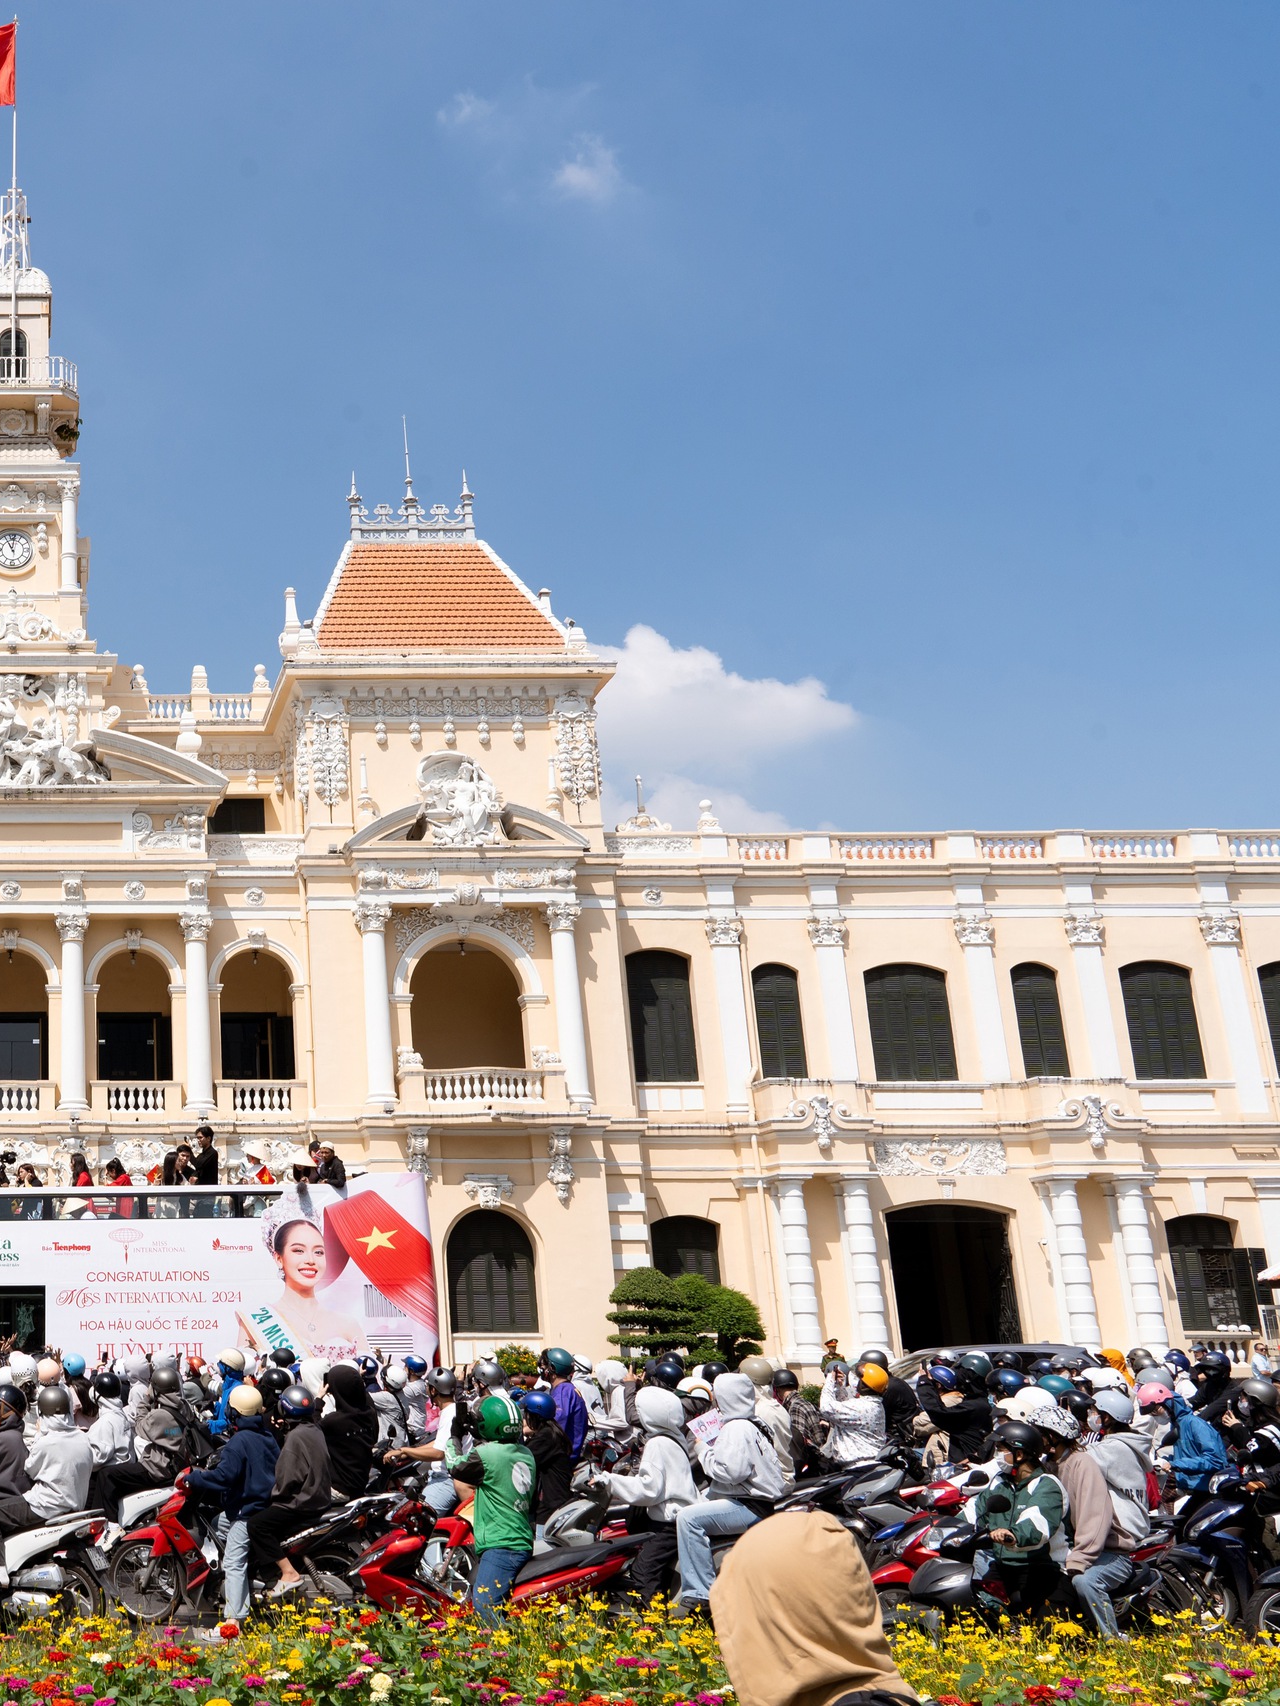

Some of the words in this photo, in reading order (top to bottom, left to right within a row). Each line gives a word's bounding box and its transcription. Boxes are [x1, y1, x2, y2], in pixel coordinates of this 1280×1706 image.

[86, 1271, 210, 1282] CONGRATULATIONS
[105, 1291, 206, 1304] INTERNATIONAL
[211, 1291, 242, 1302] 2024
[80, 1320, 105, 1330] HOA
[108, 1318, 132, 1333] HẬU
[135, 1316, 171, 1330] QUỐC
[174, 1316, 188, 1329] TẾ
[191, 1319, 218, 1329] 2024
